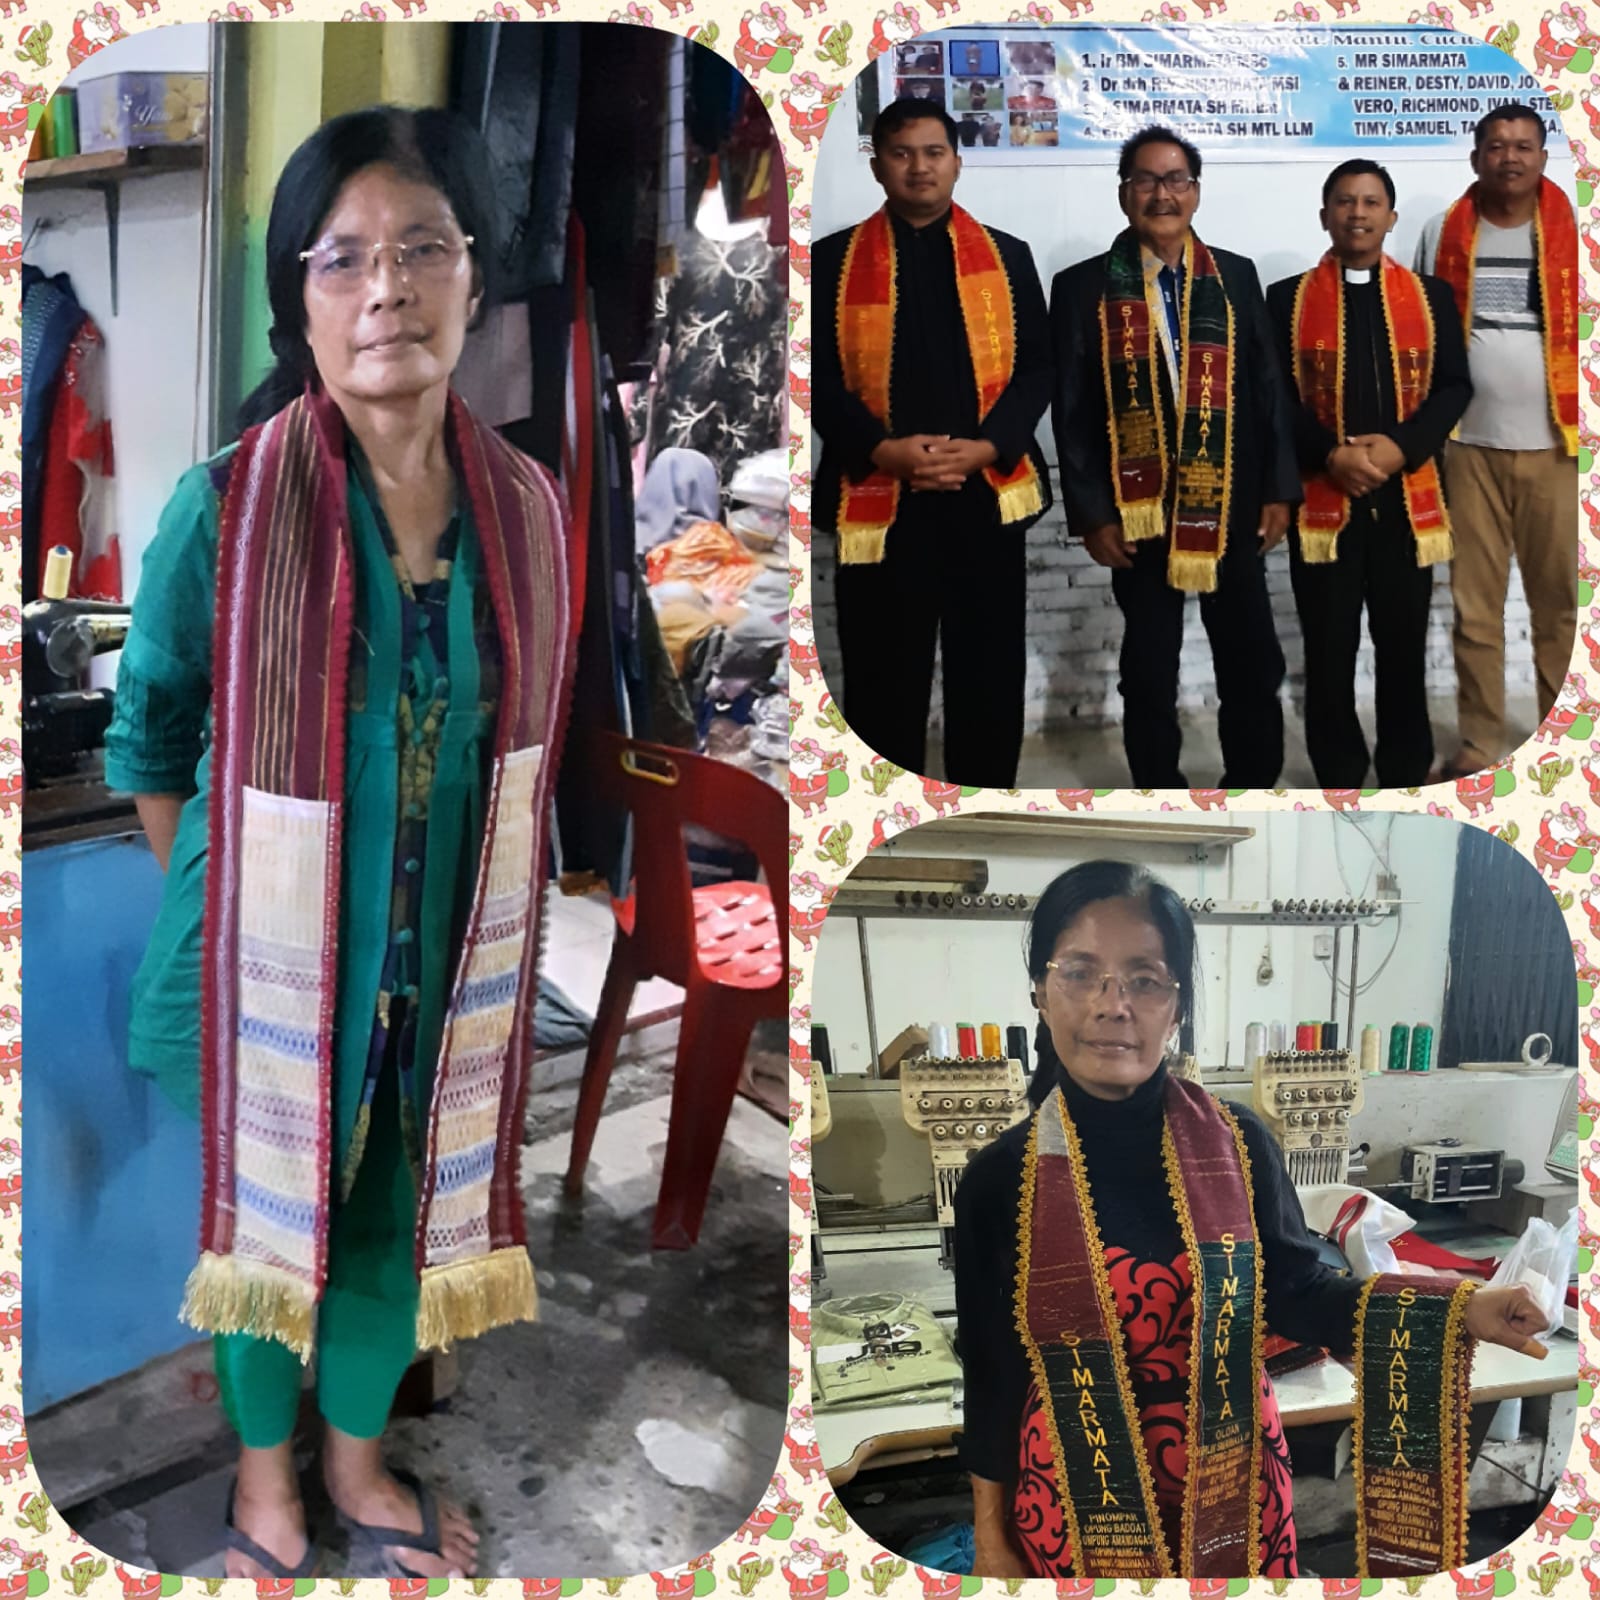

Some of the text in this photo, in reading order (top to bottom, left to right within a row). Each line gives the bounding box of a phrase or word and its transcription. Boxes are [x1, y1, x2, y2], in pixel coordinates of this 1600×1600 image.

[1144, 53, 1233, 68] SIMARMTA
[1337, 53, 1467, 68] 5. MR SIMARMATA
[1101, 76, 1117, 92] Dr
[1338, 76, 1350, 90] &
[1354, 76, 1411, 92] REINER,
[1416, 75, 1463, 92] DESTY,
[1467, 75, 1514, 91] DAVID,
[1112, 99, 1203, 115] SIMARMATA
[1206, 99, 1227, 114] SH
[1354, 98, 1397, 116] VERO,
[1402, 97, 1484, 113] RICHMOND,
[1227, 121, 1247, 136] SH
[1252, 121, 1280, 137] MTL
[1285, 121, 1314, 137] LLM
[1354, 121, 1391, 137] TIMY,
[1396, 120, 1457, 137] SAMUEL,
[1120, 305, 1139, 408] SIMARMATA
[1197, 352, 1213, 457] SIMARMATA
[1213, 1233, 1239, 1420] SIMARMATA
[1388, 1287, 1417, 1468] SIMARMATA
[1060, 1329, 1119, 1506] SIMARMATA
